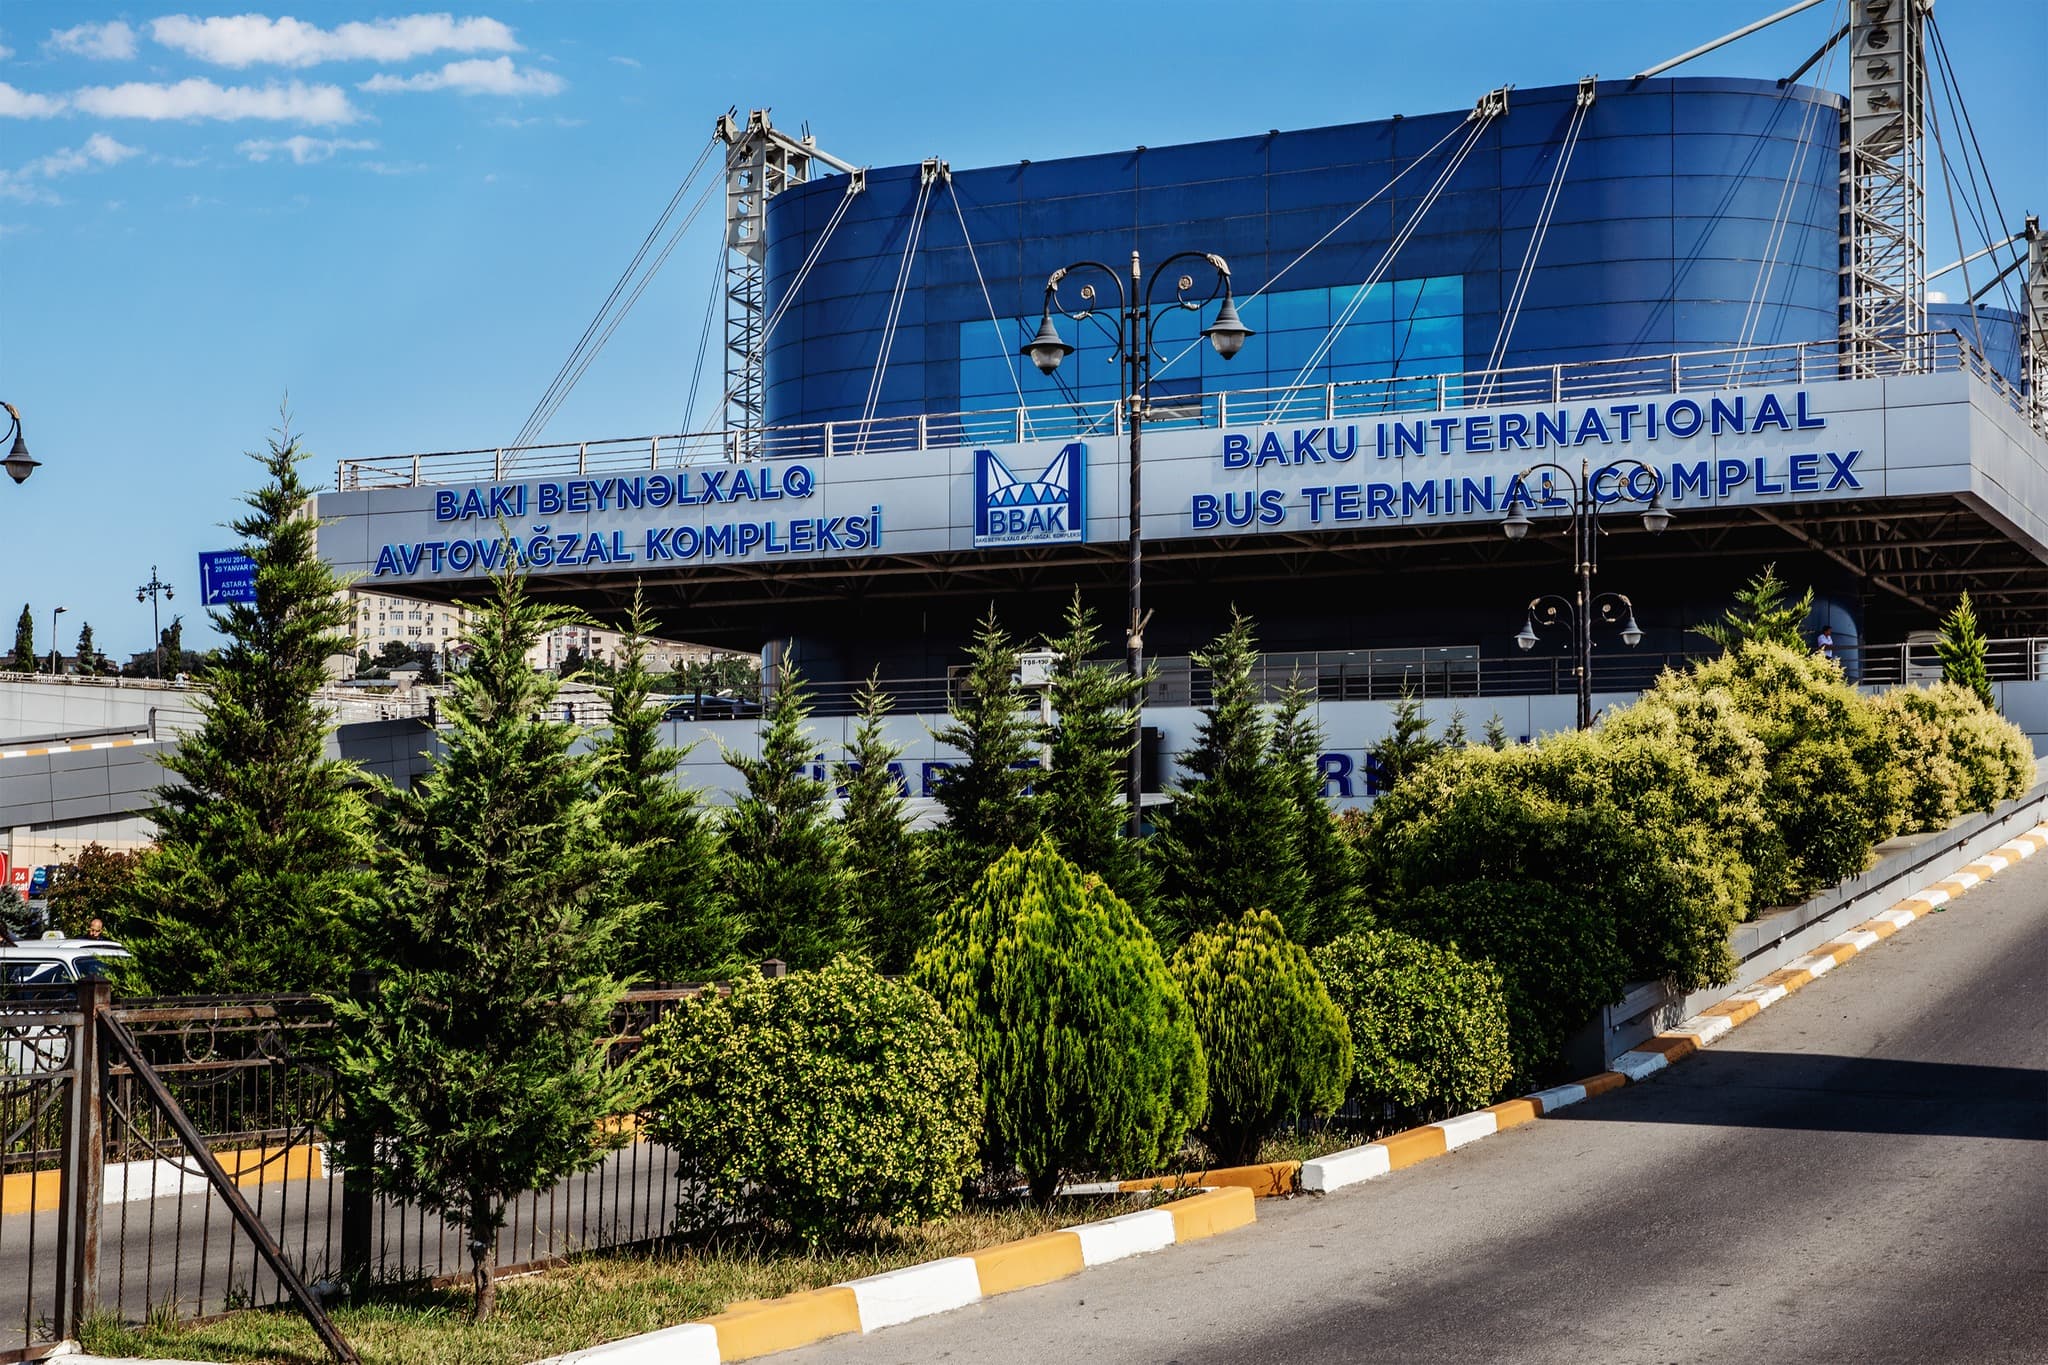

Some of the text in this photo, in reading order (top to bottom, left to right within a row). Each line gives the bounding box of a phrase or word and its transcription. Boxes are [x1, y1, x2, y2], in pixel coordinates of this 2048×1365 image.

[1222, 390, 1827, 470] BAKU INTERNATIONAL
[435, 464, 815, 522] BAKI BEYNƏLXALQ
[1191, 449, 1862, 529] BUS TERMINAL COMPLEX
[373, 504, 882, 577] AVTOVAĞZAL KOMPLEKSİ
[989, 506, 1065, 535] BBAK
[222, 580, 247, 588] ASTARA
[222, 589, 244, 597] QAZAX
[15, 871, 25, 881] 24
